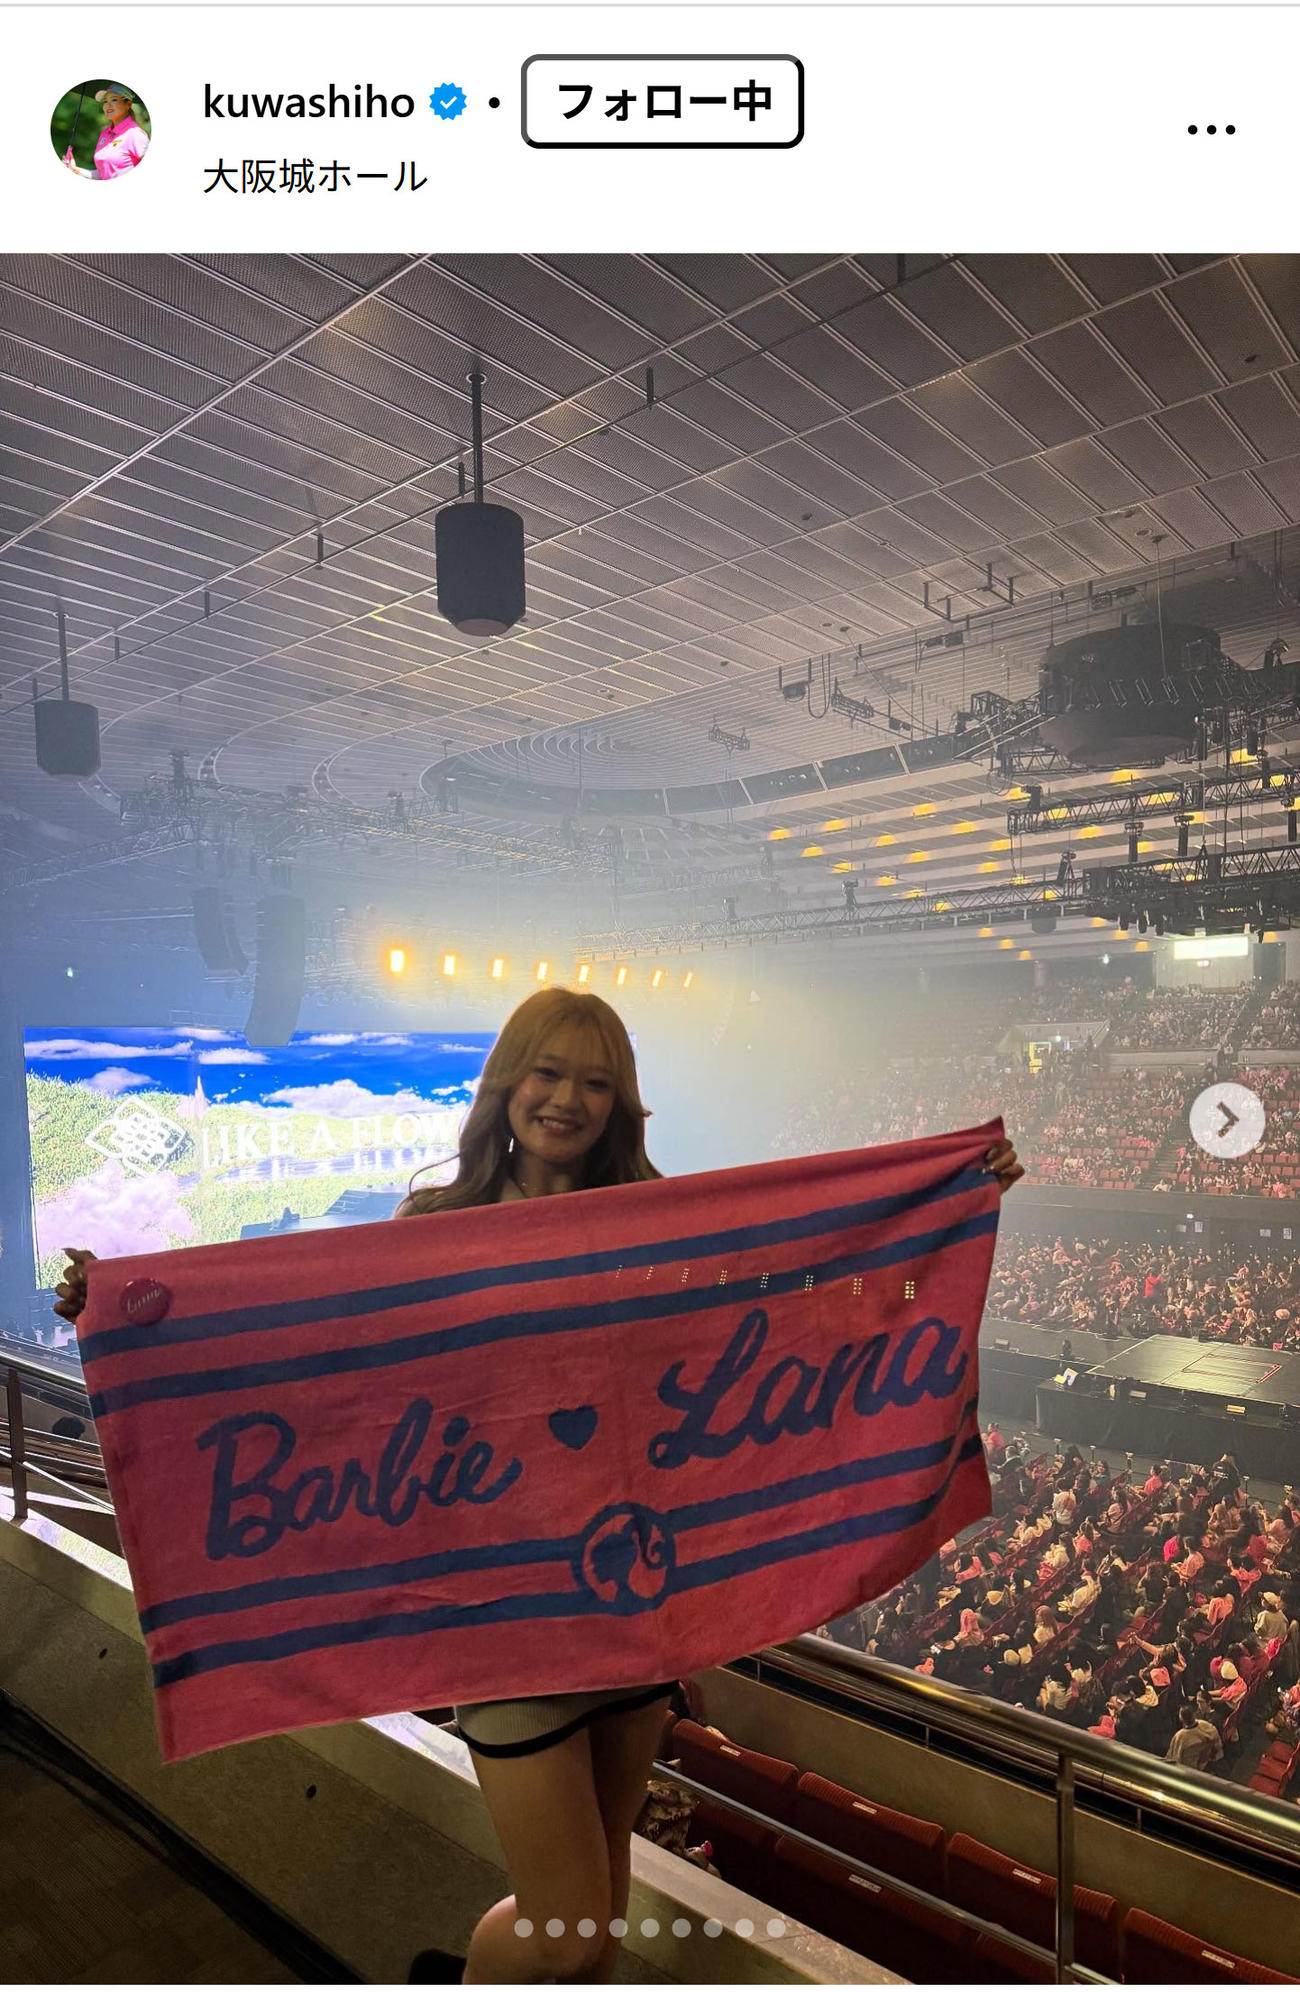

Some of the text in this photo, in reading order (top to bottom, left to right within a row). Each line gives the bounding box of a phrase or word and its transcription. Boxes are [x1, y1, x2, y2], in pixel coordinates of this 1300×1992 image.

[201, 1121, 296, 1169] LIKE
[306, 1119, 338, 1152] A
[195, 1308, 969, 1560] Barbie Lana
